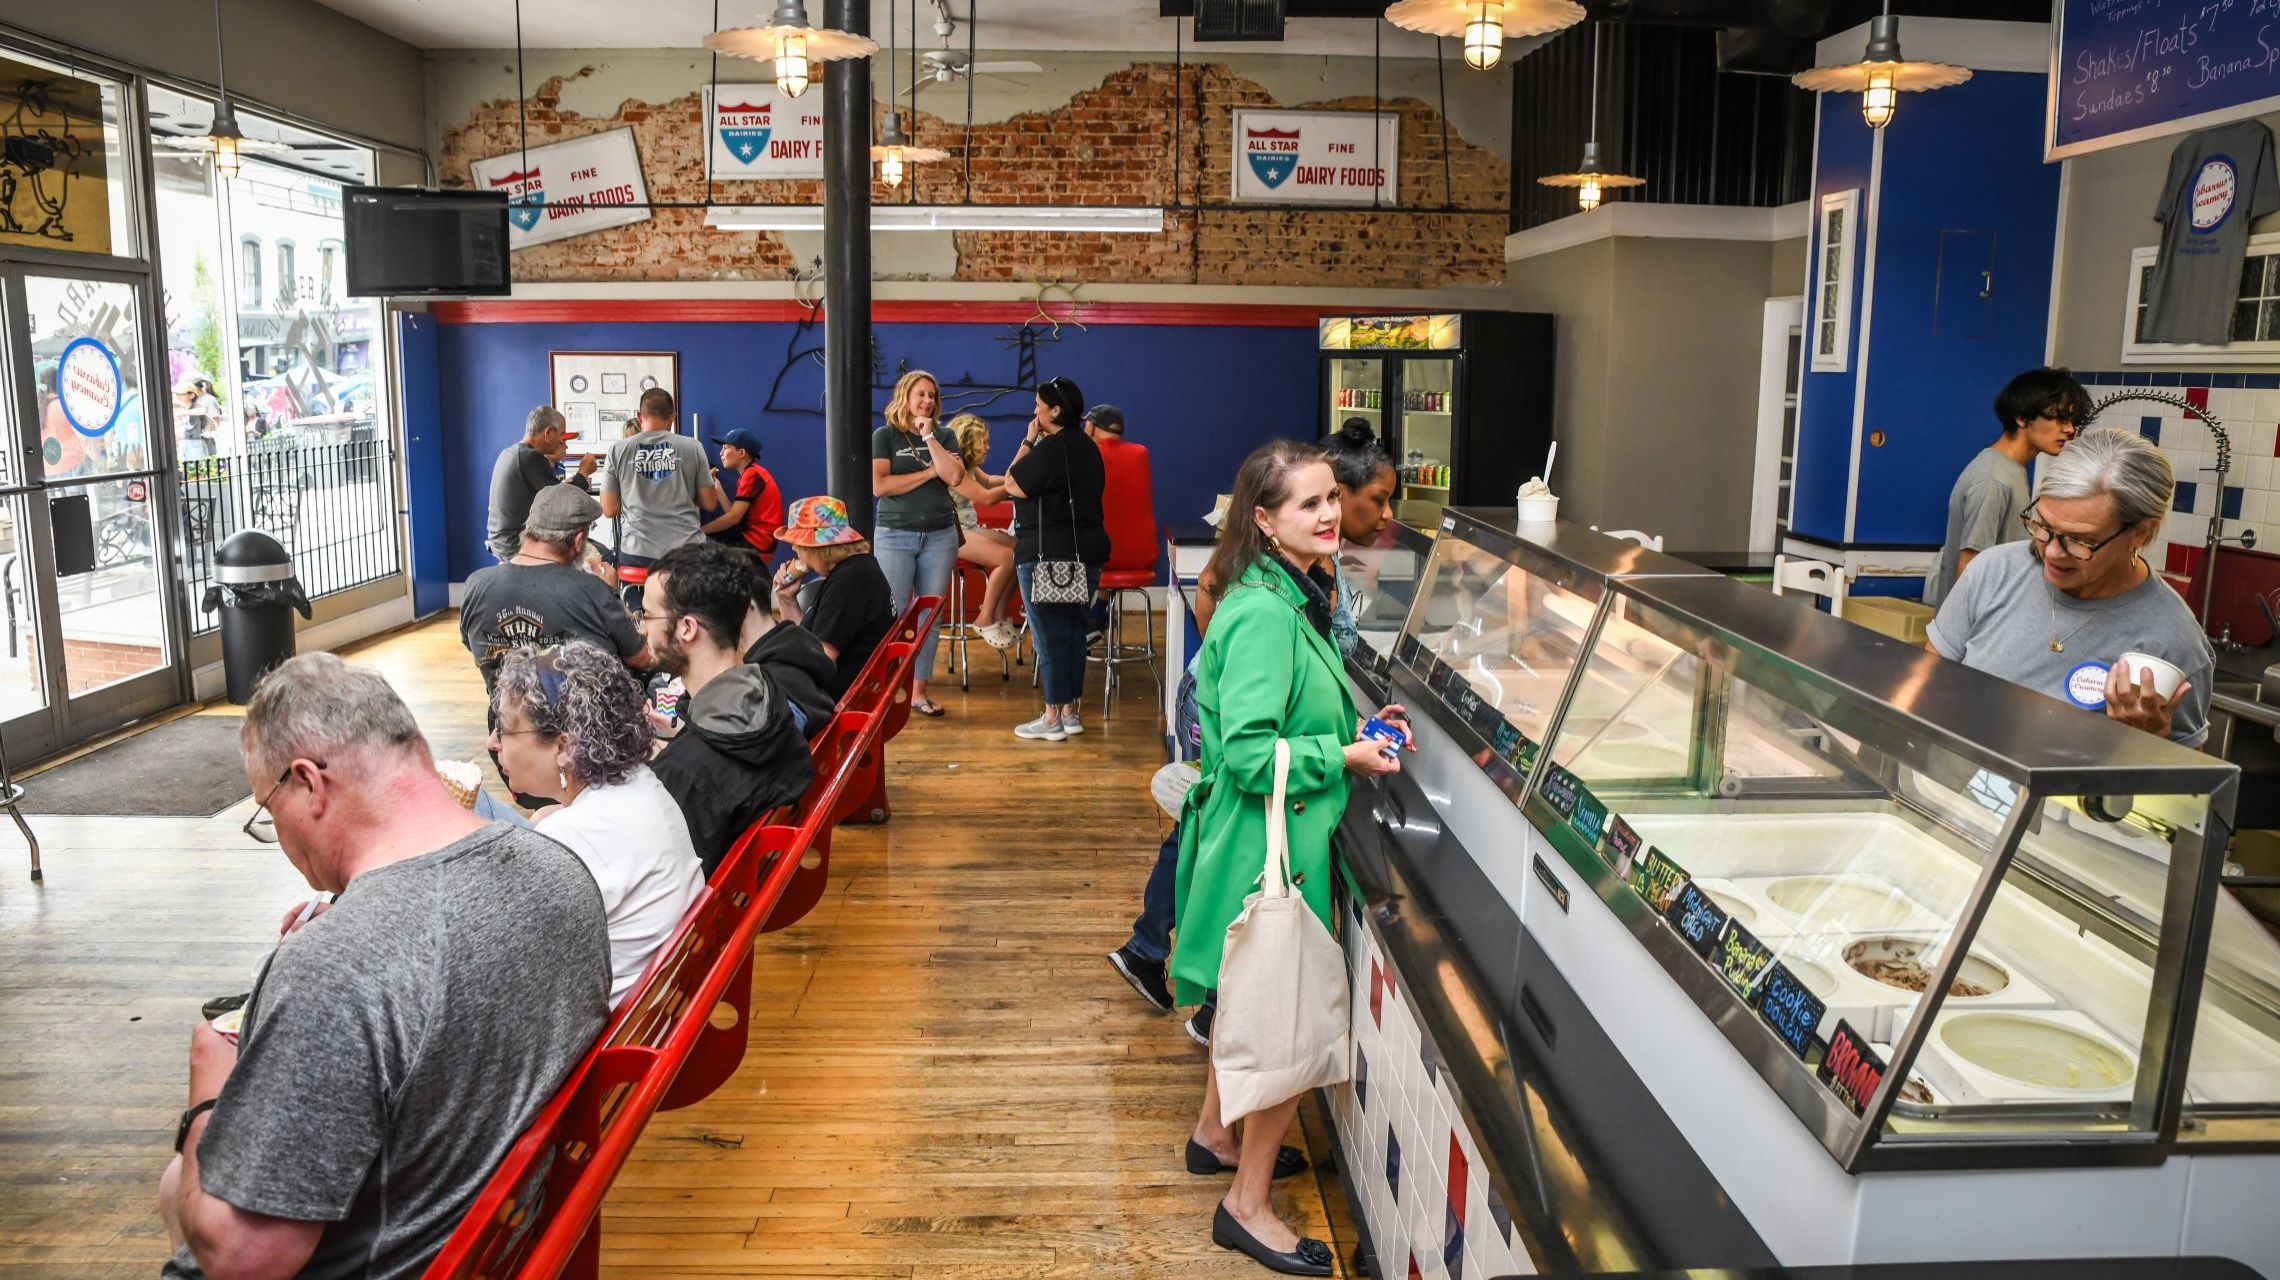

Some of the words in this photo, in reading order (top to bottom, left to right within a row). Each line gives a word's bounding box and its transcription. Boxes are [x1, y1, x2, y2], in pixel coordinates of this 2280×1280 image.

[2073, 83, 2145, 121] Sundaes
[2187, 55, 2252, 89] Banana
[720, 115, 739, 126] ALL
[742, 116, 770, 126] STAR
[801, 115, 823, 126] FIN
[770, 140, 811, 159] DAIRY
[1248, 140, 1267, 151] ALL
[1270, 140, 1299, 152] STAR
[1328, 143, 1356, 154] FINE
[570, 167, 598, 182] FINE
[1296, 166, 1337, 186] DAIRY
[1340, 167, 1386, 187] FOODS
[514, 179, 543, 195] STAR
[547, 194, 586, 221] DAIRY
[588, 183, 635, 212] FOODS
[635, 460, 676, 473] STRONG
[515, 605, 544, 625] Annual
[504, 620, 538, 638] RUN
[1646, 853, 1684, 891] BUTTER
[1723, 954, 1753, 1000] Pudding
[1763, 997, 1803, 1049] DOUGH
